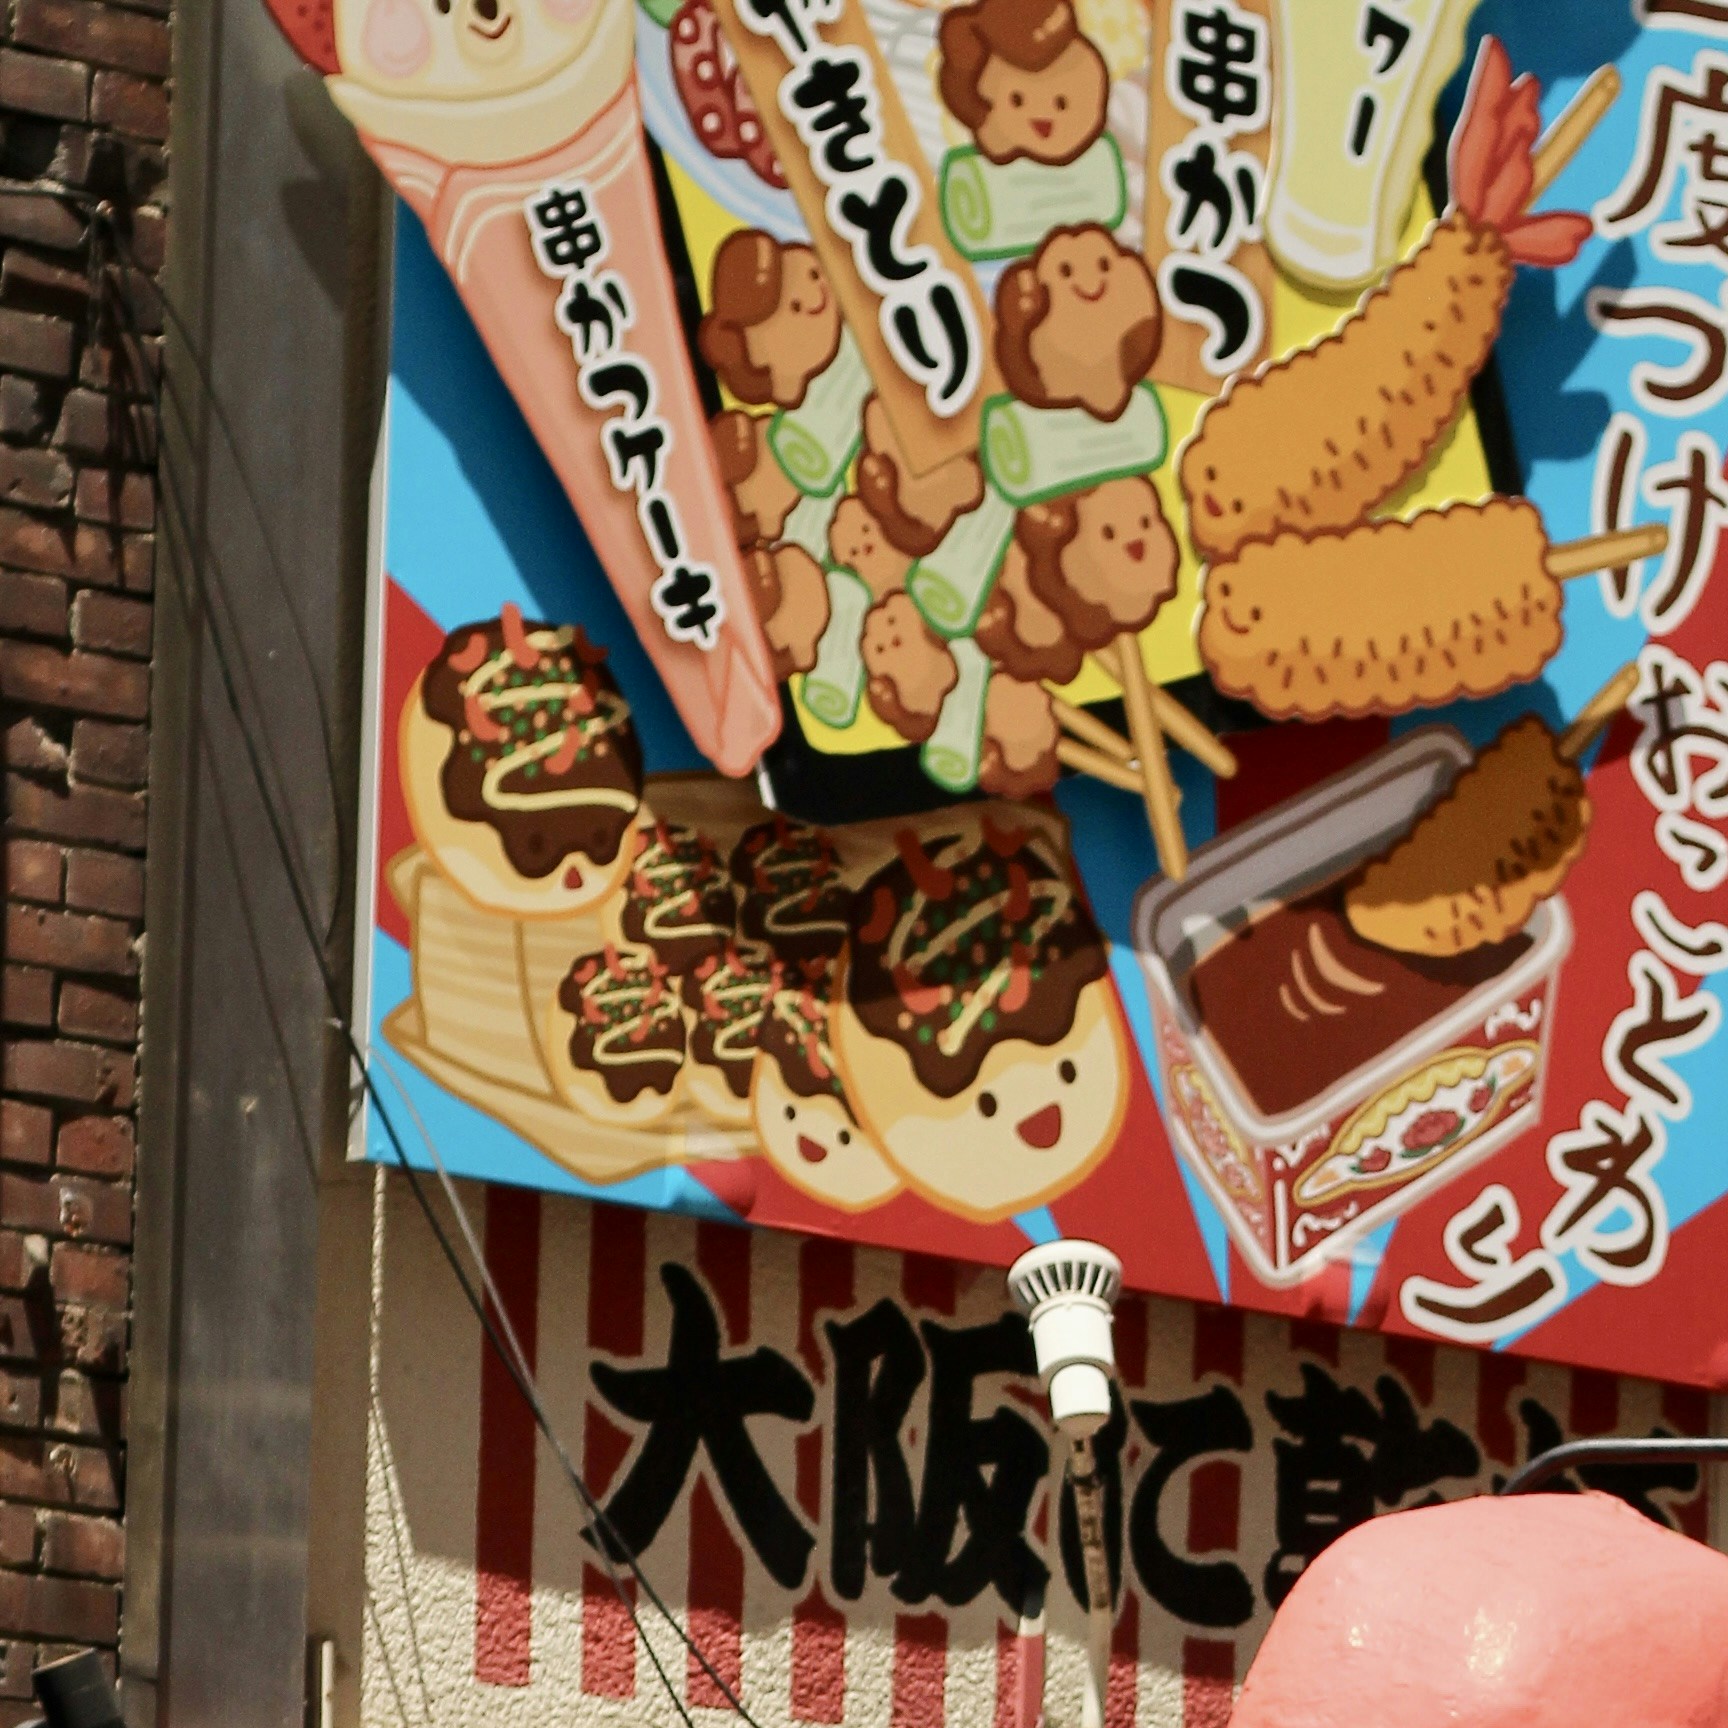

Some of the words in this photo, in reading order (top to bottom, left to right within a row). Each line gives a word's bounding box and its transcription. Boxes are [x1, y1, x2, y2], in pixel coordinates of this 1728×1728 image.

[1170, 6, 1256, 360] 串かつ
[534, 189, 720, 642] 串かつケーキ
